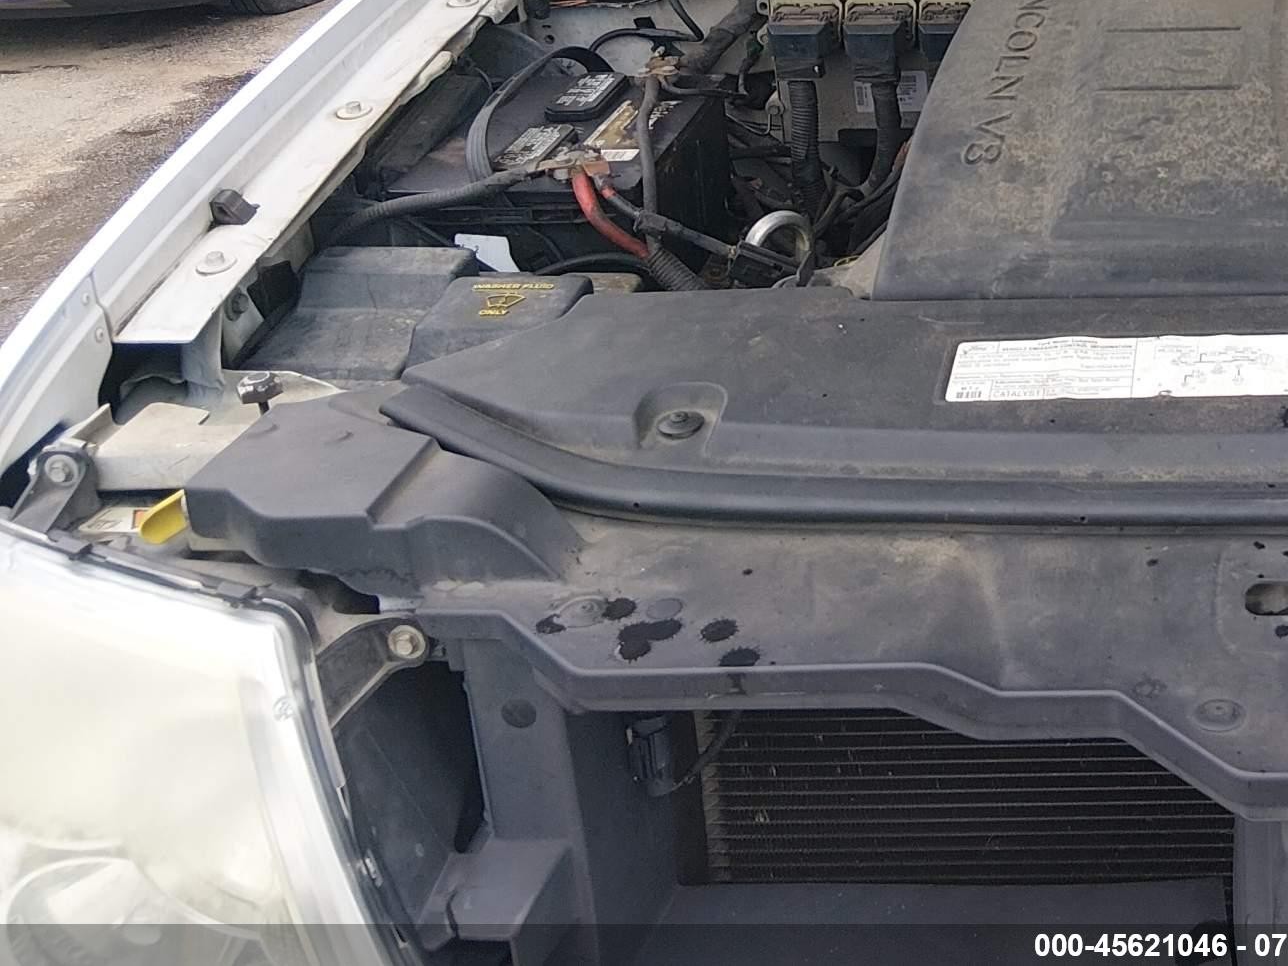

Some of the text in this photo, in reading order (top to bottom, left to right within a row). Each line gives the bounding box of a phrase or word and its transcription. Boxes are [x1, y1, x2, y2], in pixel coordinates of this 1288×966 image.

[963, 112, 1013, 165] V8
[472, 282, 555, 290] WASHER FLUID
